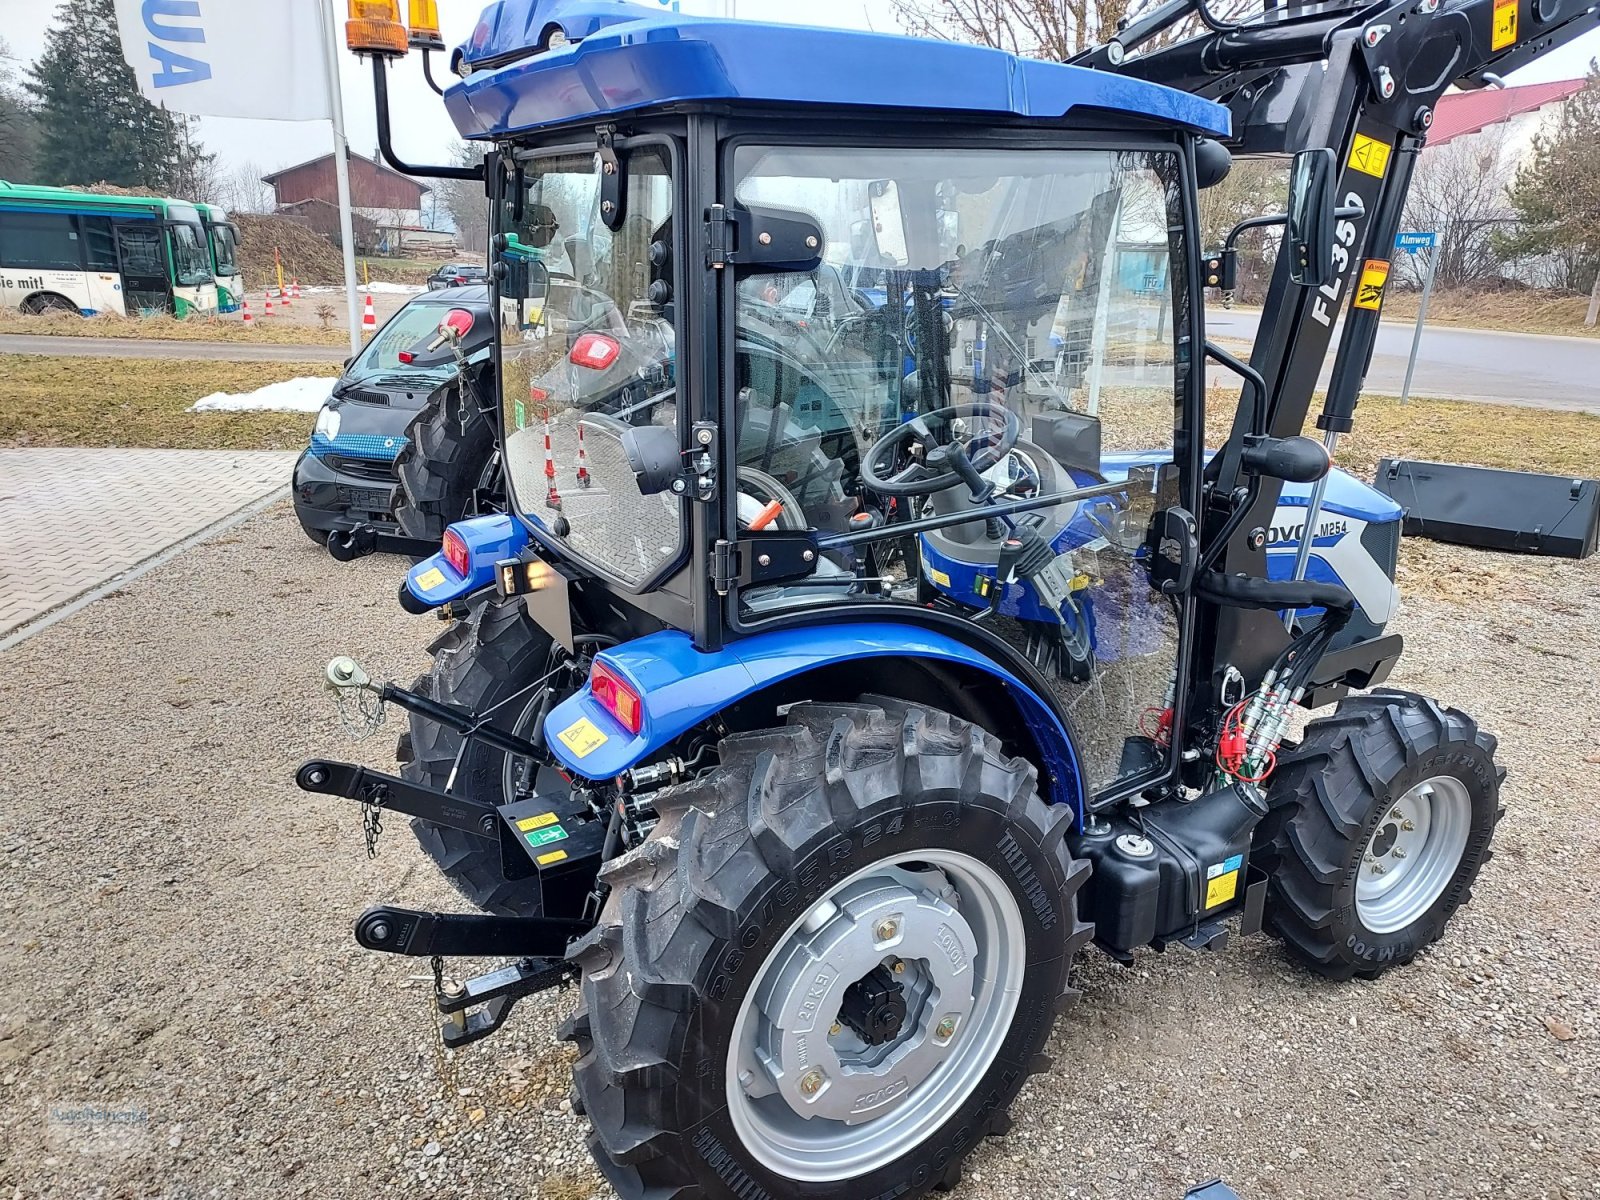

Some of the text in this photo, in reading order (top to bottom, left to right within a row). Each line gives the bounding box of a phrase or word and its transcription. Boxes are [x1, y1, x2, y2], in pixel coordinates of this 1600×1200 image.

[1400, 234, 1431, 247] Almweg
[0, 275, 13, 289] ie
[17, 276, 45, 290] mit!
[1320, 520, 1347, 537] M254
[995, 827, 1058, 931] TRELLEBORG
[1345, 933, 1376, 961] 700
